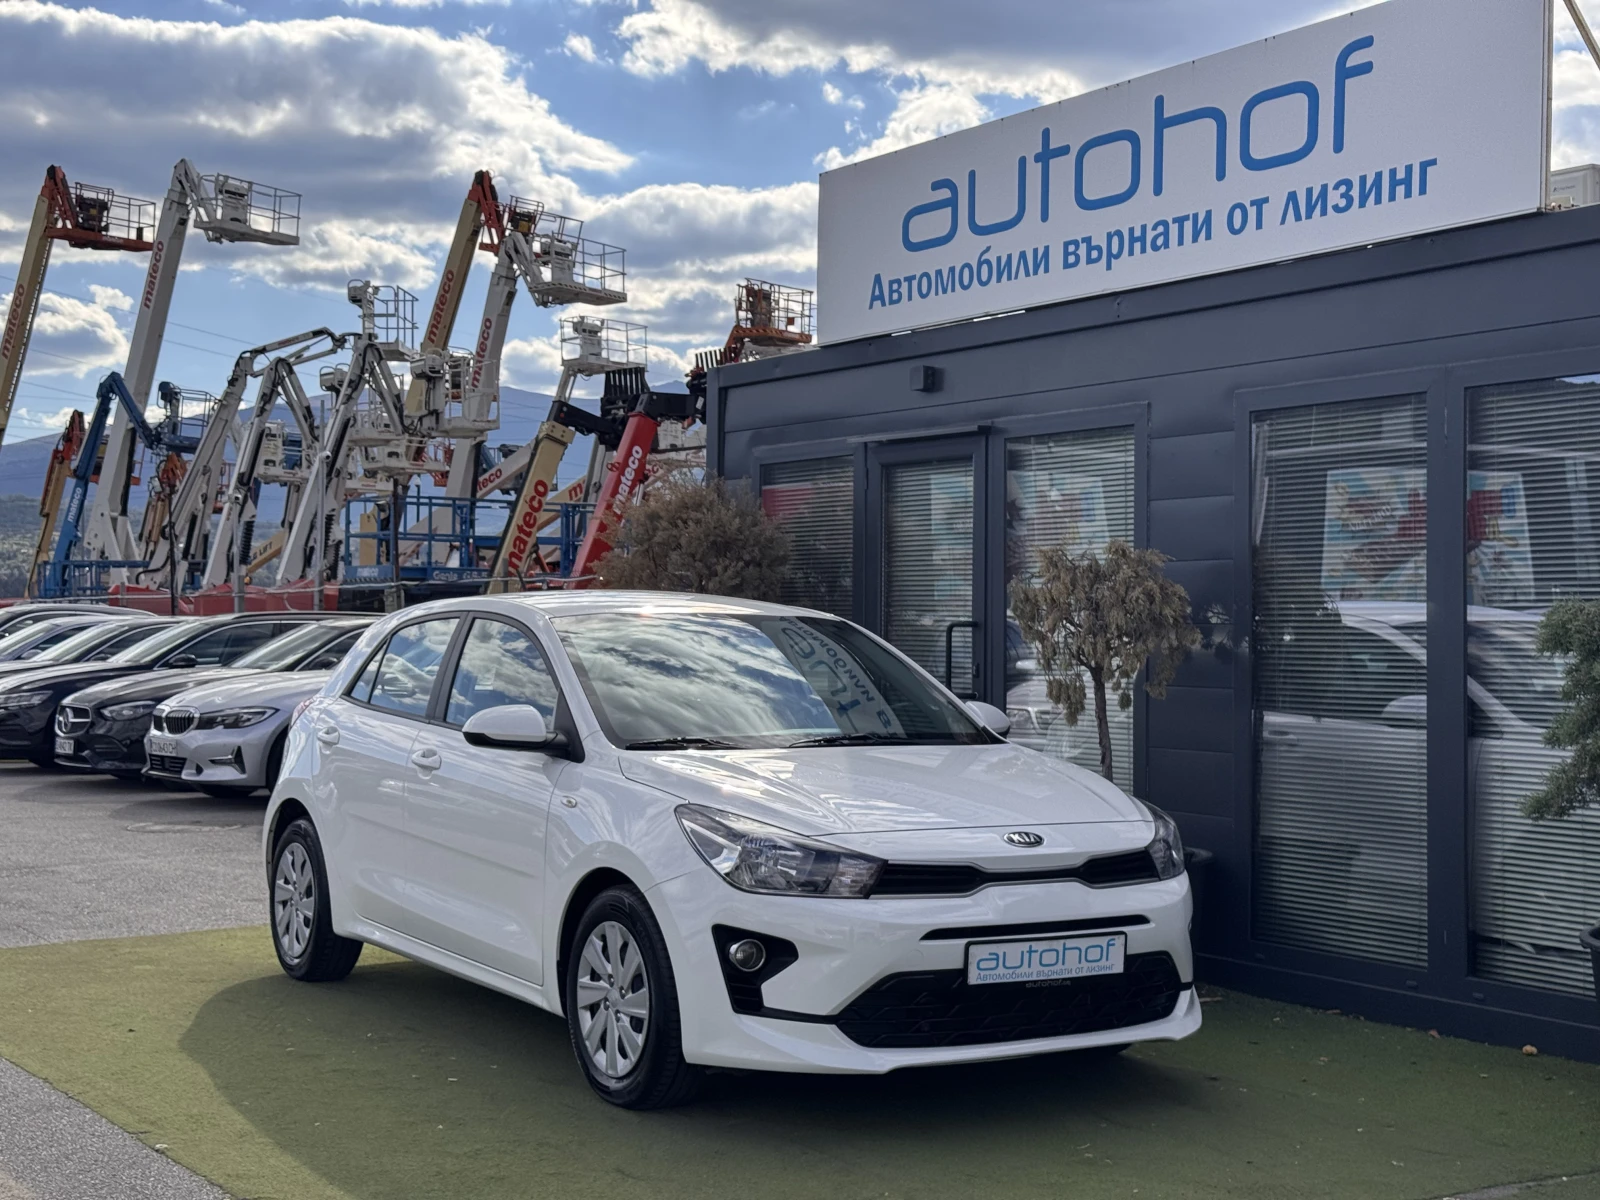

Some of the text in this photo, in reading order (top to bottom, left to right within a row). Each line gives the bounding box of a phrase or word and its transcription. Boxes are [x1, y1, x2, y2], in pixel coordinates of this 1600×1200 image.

[902, 35, 1374, 252] autohof
[868, 157, 1438, 310] Автомобили върнати от лизинг
[144, 240, 164, 310] mateco
[428, 269, 455, 344] mateco
[2, 284, 25, 360] mateco
[471, 317, 493, 388] mateco
[67, 487, 82, 523] mateco
[613, 445, 643, 515] mateco
[508, 480, 549, 578] mateco
[432, 570, 458, 582] Genie
[1006, 832, 1042, 844] KIA
[976, 938, 1116, 971] autohof
[976, 963, 1115, 982] Автомобили върнати от лизинг
